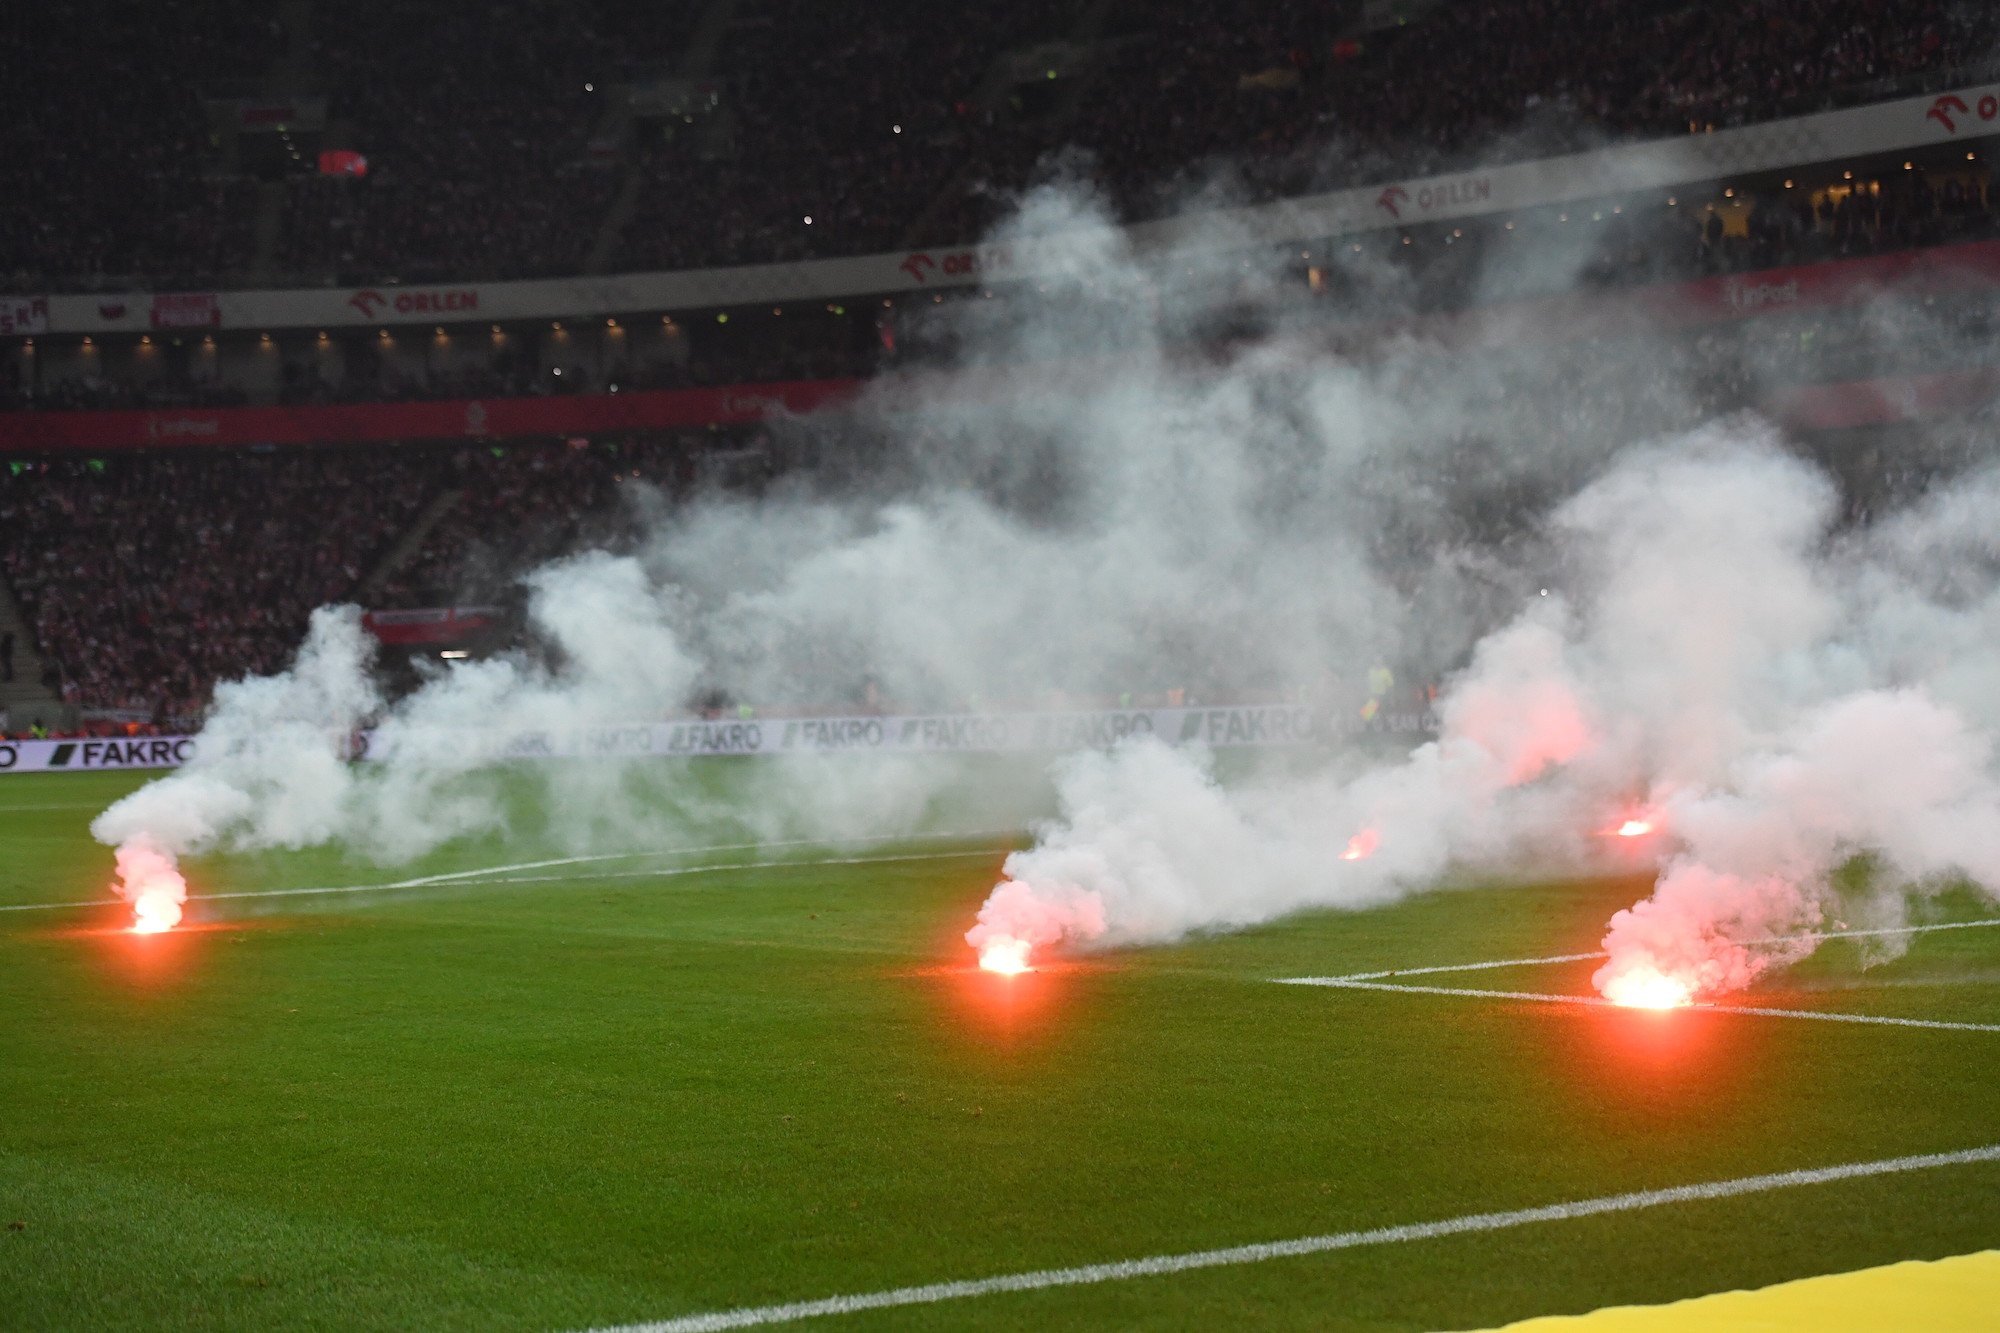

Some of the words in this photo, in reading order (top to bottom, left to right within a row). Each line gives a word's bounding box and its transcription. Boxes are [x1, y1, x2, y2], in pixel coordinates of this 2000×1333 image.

[1418, 179, 1488, 210] ORLEN
[394, 283, 479, 312] ORLEN
[690, 723, 761, 750] FAKRO
[803, 719, 884, 748] FAKRO
[1207, 708, 1315, 744] FAKRO
[84, 739, 196, 767] FAKRO
